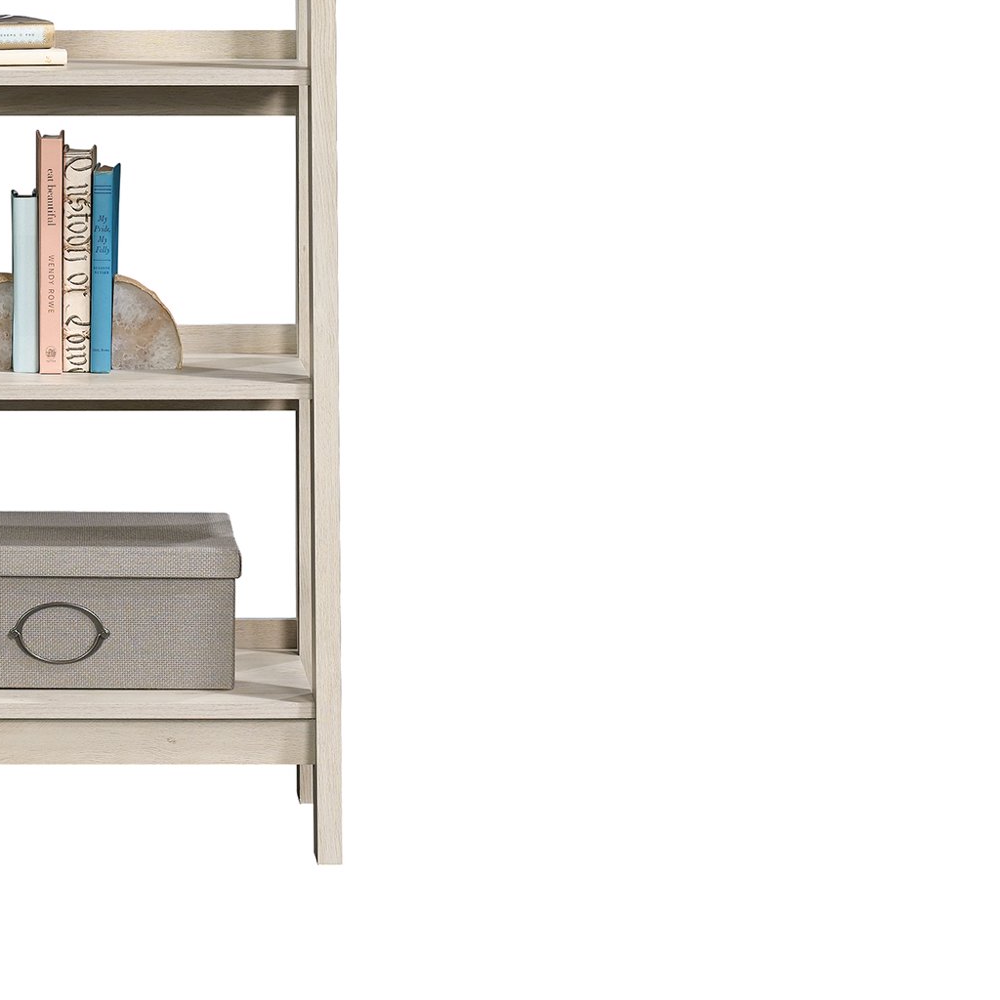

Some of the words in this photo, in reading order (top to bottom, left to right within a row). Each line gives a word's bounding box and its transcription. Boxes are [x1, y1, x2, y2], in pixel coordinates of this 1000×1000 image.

[46, 168, 54, 182] eat
[47, 184, 57, 226] beautiful
[48, 254, 56, 287] WENDY
[47, 288, 55, 314] ROWE
